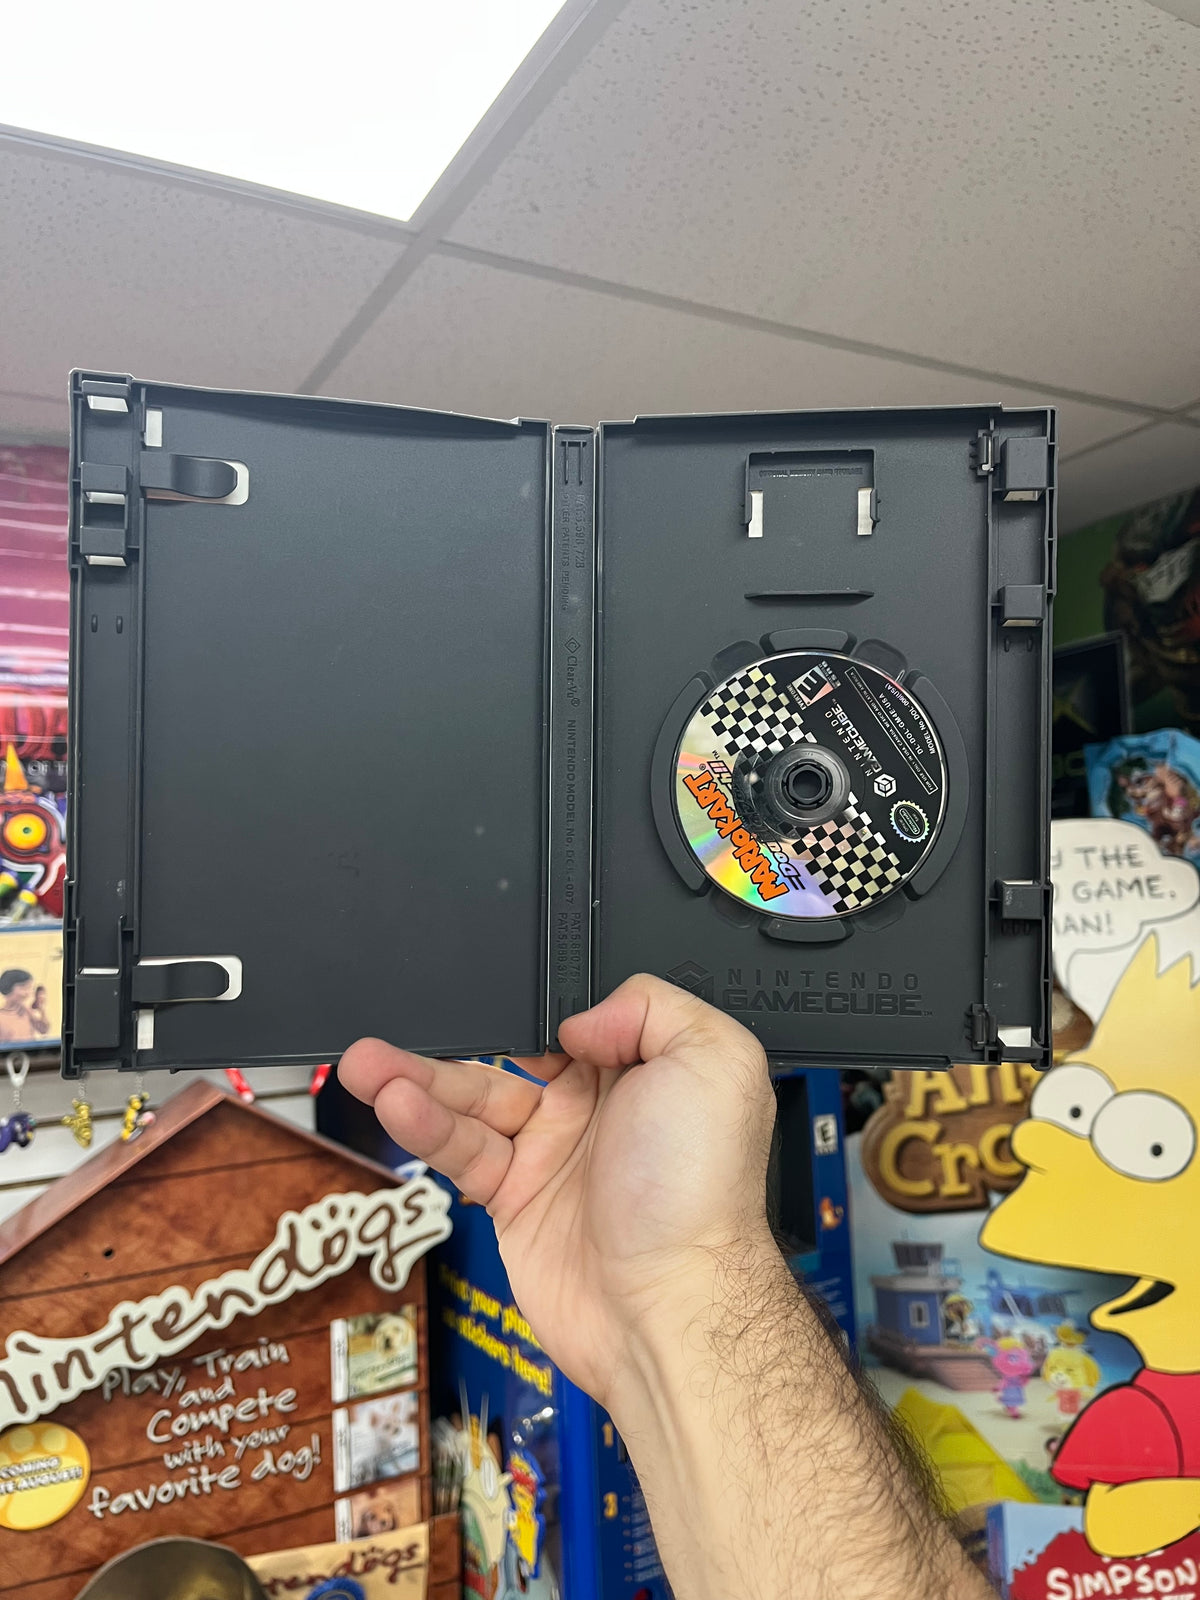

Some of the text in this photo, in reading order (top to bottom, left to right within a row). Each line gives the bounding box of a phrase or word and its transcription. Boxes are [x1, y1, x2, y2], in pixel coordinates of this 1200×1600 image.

[567, 720, 576, 781] NINTENDO
[824, 710, 873, 777] NINTENDO
[831, 703, 883, 773] GAMECUBE
[1076, 845, 1143, 869] THE
[1072, 876, 1177, 903] GAME.
[1054, 912, 1113, 935] AN!
[727, 968, 920, 991] NINTENDO
[721, 988, 923, 1016] GAMECUBE
[193, 1337, 290, 1378] Train
[178, 1375, 236, 1409] and
[146, 1387, 298, 1443] Compete
[164, 1424, 290, 1470] with your
[88, 1464, 242, 1519] favorite
[251, 1432, 322, 1480] dog!
[1046, 1558, 1200, 1600] SIMPSON
